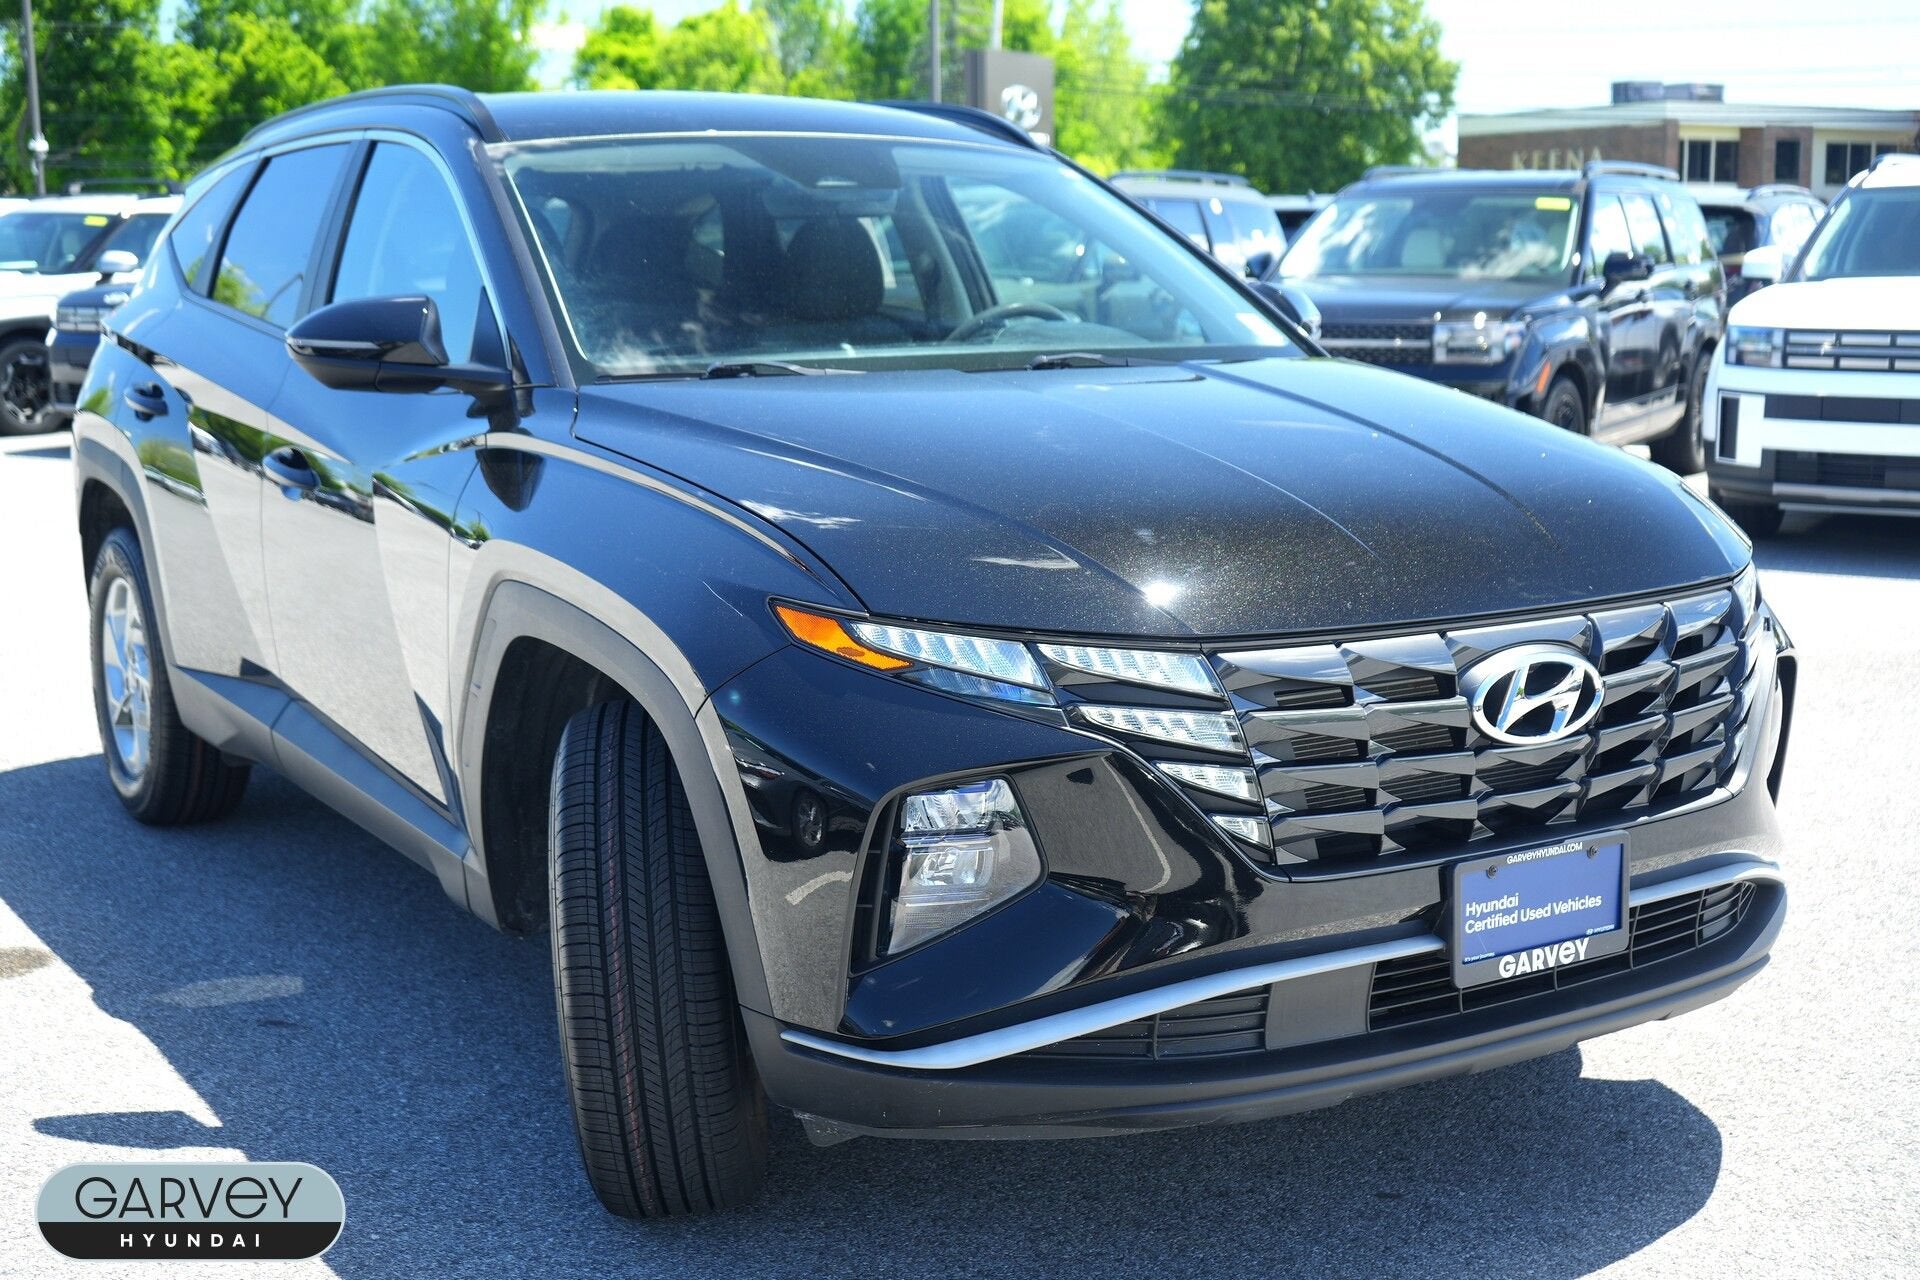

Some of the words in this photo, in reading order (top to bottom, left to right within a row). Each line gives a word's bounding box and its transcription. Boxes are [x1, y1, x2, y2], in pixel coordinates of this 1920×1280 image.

[1465, 893, 1519, 918] Hyundai
[1465, 911, 1518, 934] Certified
[1520, 903, 1551, 922] Used
[1553, 894, 1602, 915] Vehicles
